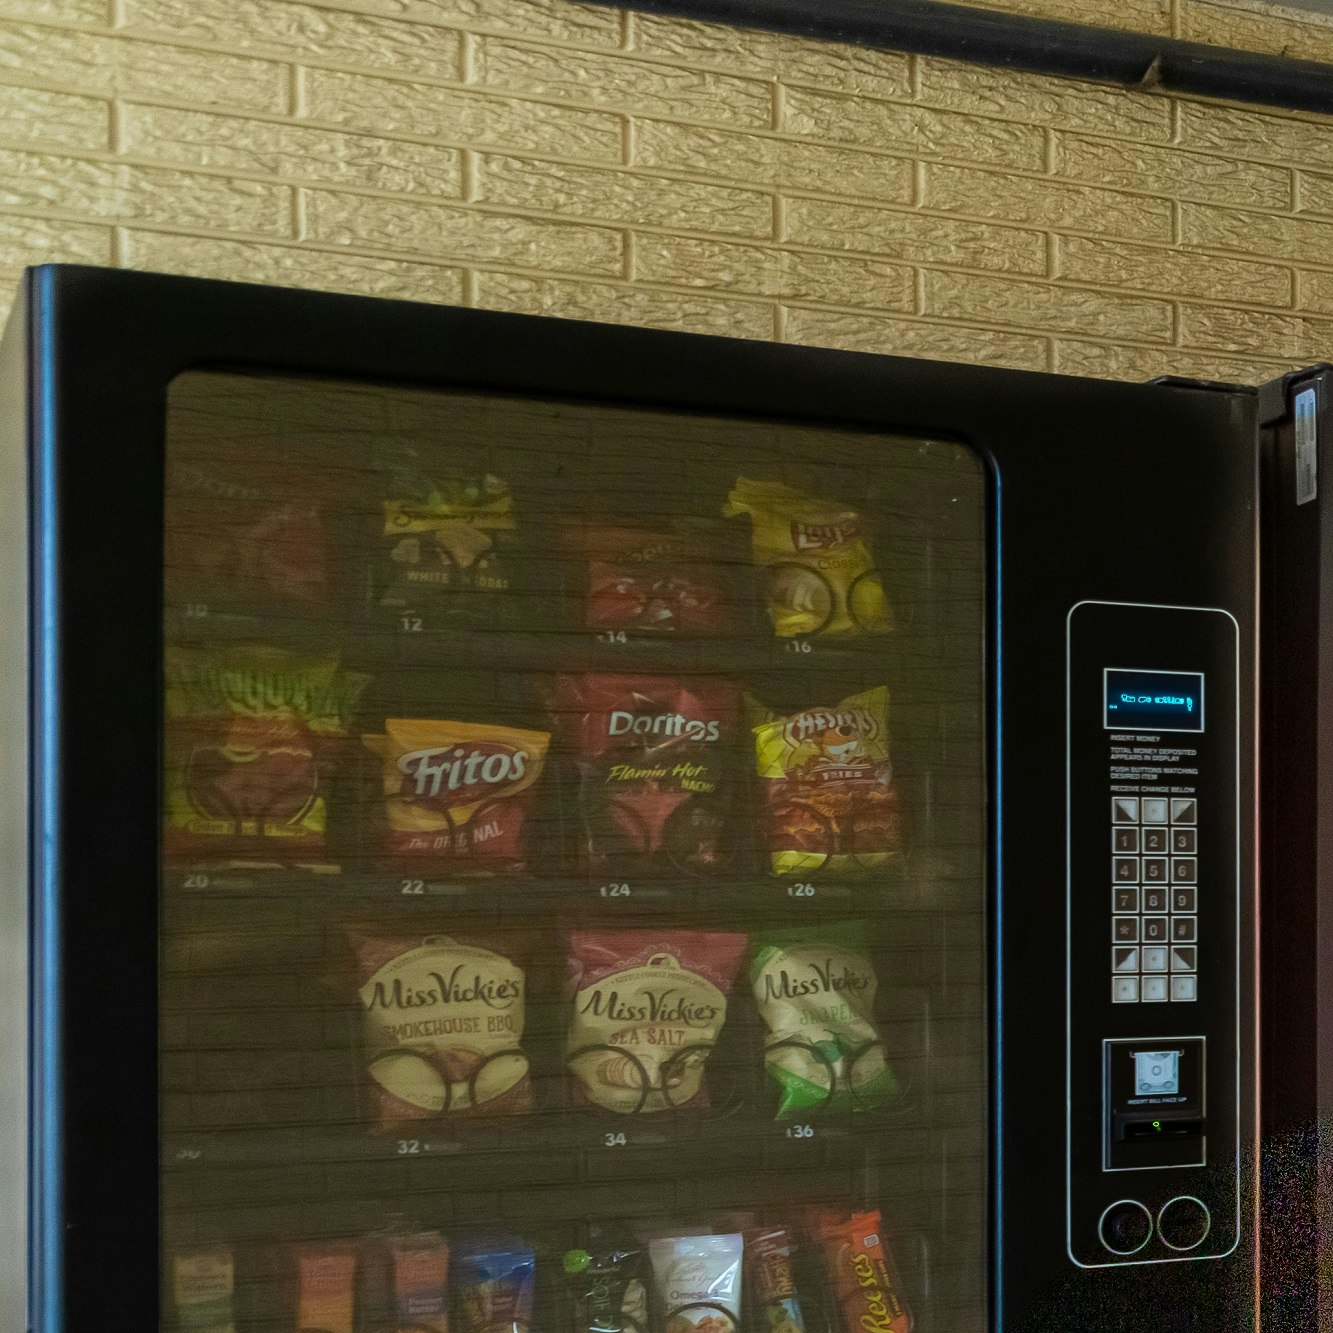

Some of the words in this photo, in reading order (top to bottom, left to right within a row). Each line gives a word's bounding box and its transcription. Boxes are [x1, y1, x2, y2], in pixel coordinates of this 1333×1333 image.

[401, 618, 423, 632] 12
[607, 630, 627, 644] 14
[793, 640, 812, 654] 16
[608, 710, 720, 743] Doritos
[397, 747, 530, 799] Fritos
[671, 760, 708, 778] Hot
[1121, 835, 1128, 847] 1
[1149, 835, 1158, 847] 2
[1178, 836, 1187, 847] 3
[1120, 865, 1129, 877] 4
[1149, 865, 1158, 877] 5
[1178, 865, 1187, 877] 6
[401, 879, 425, 894] 22
[607, 883, 631, 898] 24
[793, 883, 815, 898] 26
[1120, 895, 1129, 906] 7
[1149, 895, 1158, 907] 8
[1178, 895, 1187, 907] 9
[1149, 924, 1158, 936] 0
[367, 978, 437, 1011] Miss
[429, 963, 521, 1010] Vickie's
[764, 970, 819, 1005] Miss
[580, 990, 645, 1022] Miss
[643, 989, 721, 1029] Vickie's
[384, 1017, 481, 1040] SMOKEHOUSE
[487, 1014, 514, 1035] BBQ
[609, 1028, 639, 1046] SEA
[646, 1028, 686, 1047] SALT
[792, 1125, 814, 1139] 36
[605, 1132, 627, 1147] 34
[397, 1140, 421, 1154] 32
